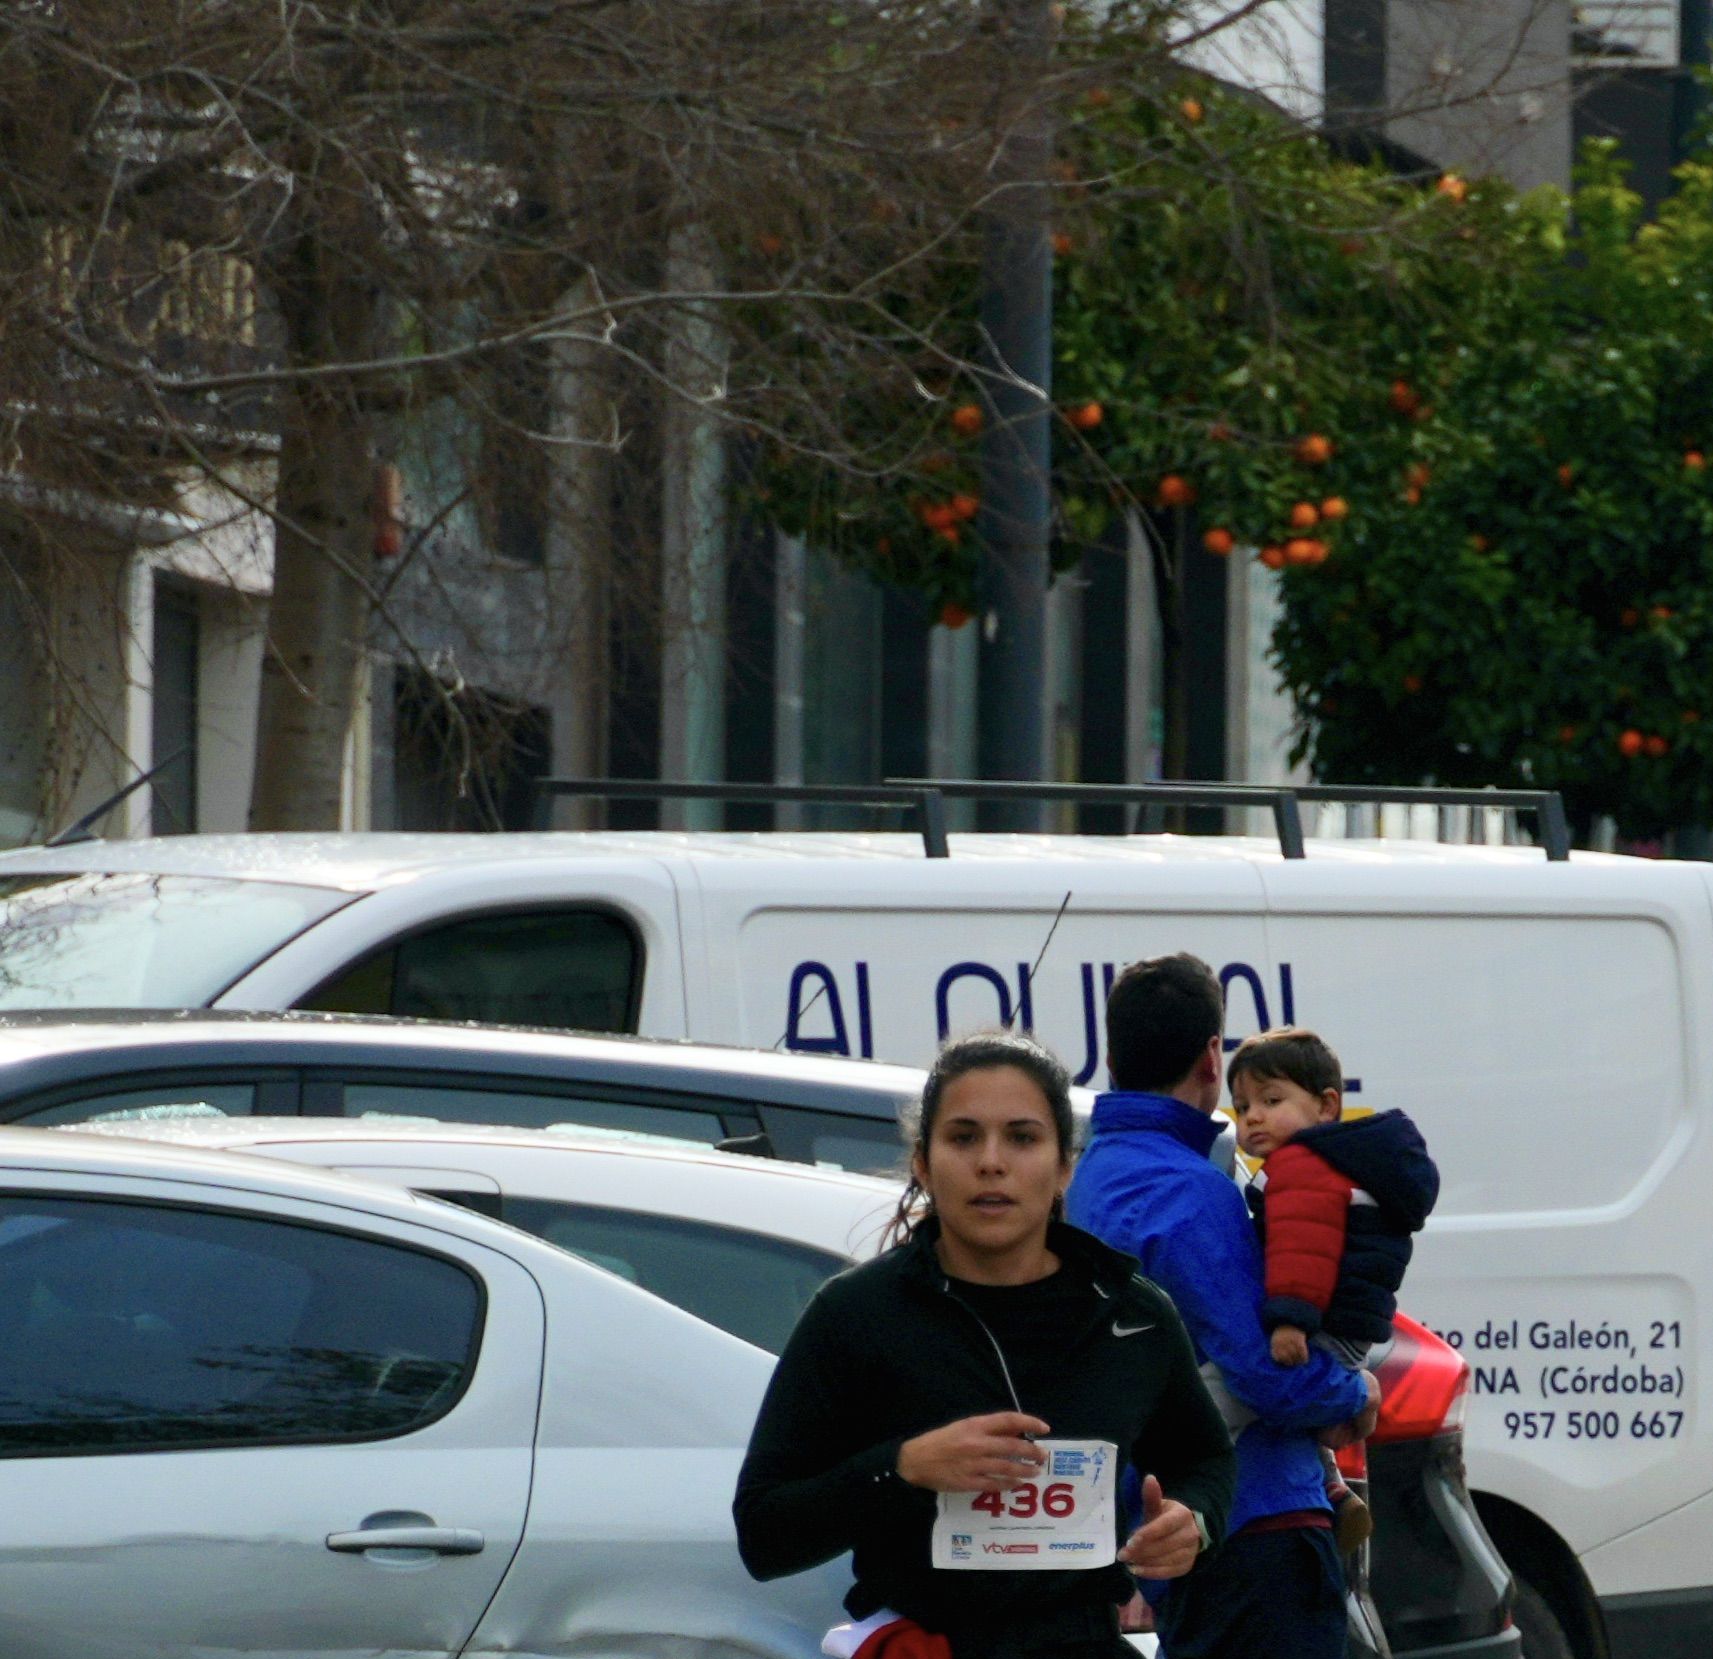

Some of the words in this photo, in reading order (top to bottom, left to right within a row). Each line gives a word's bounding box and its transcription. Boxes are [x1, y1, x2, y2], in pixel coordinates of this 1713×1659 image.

[1475, 1320, 1518, 1349] del
[1529, 1320, 1636, 1358] Galeón,
[1650, 1321, 1681, 1349] 21
[1540, 1365, 1684, 1398] (Córdoba)
[1504, 1412, 1555, 1438] 957
[1567, 1412, 1619, 1438] 500
[1630, 1412, 1684, 1438] 667
[971, 1482, 1076, 1519] 436
